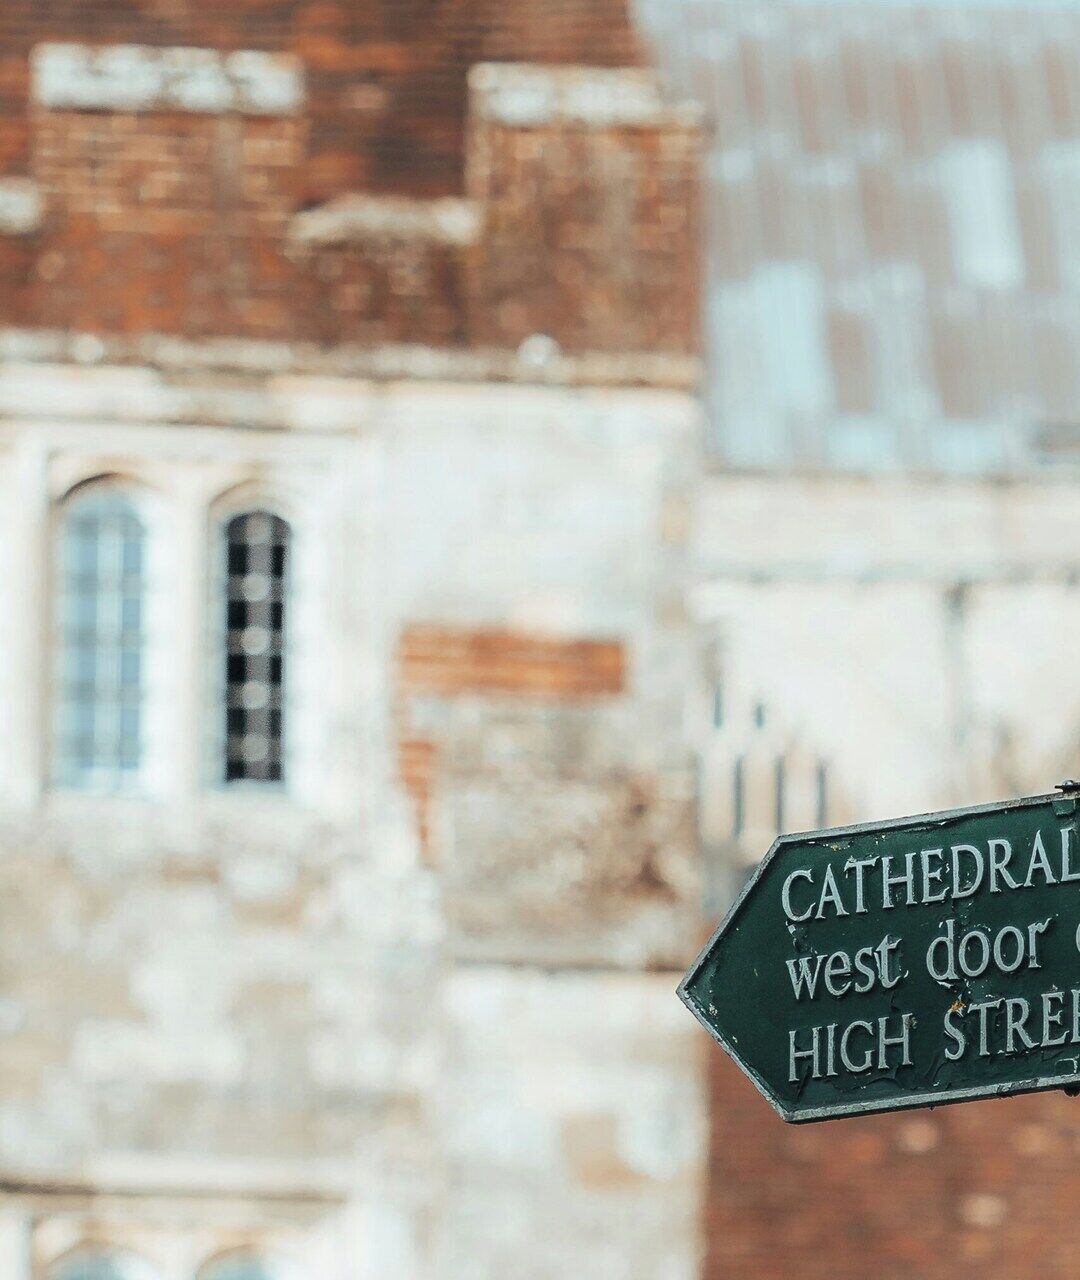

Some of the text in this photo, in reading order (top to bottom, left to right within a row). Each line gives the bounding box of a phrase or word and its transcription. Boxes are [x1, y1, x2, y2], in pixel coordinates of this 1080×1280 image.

[785, 934, 903, 1000] west
[926, 919, 1052, 981] door
[788, 1013, 914, 1082] HIGH
